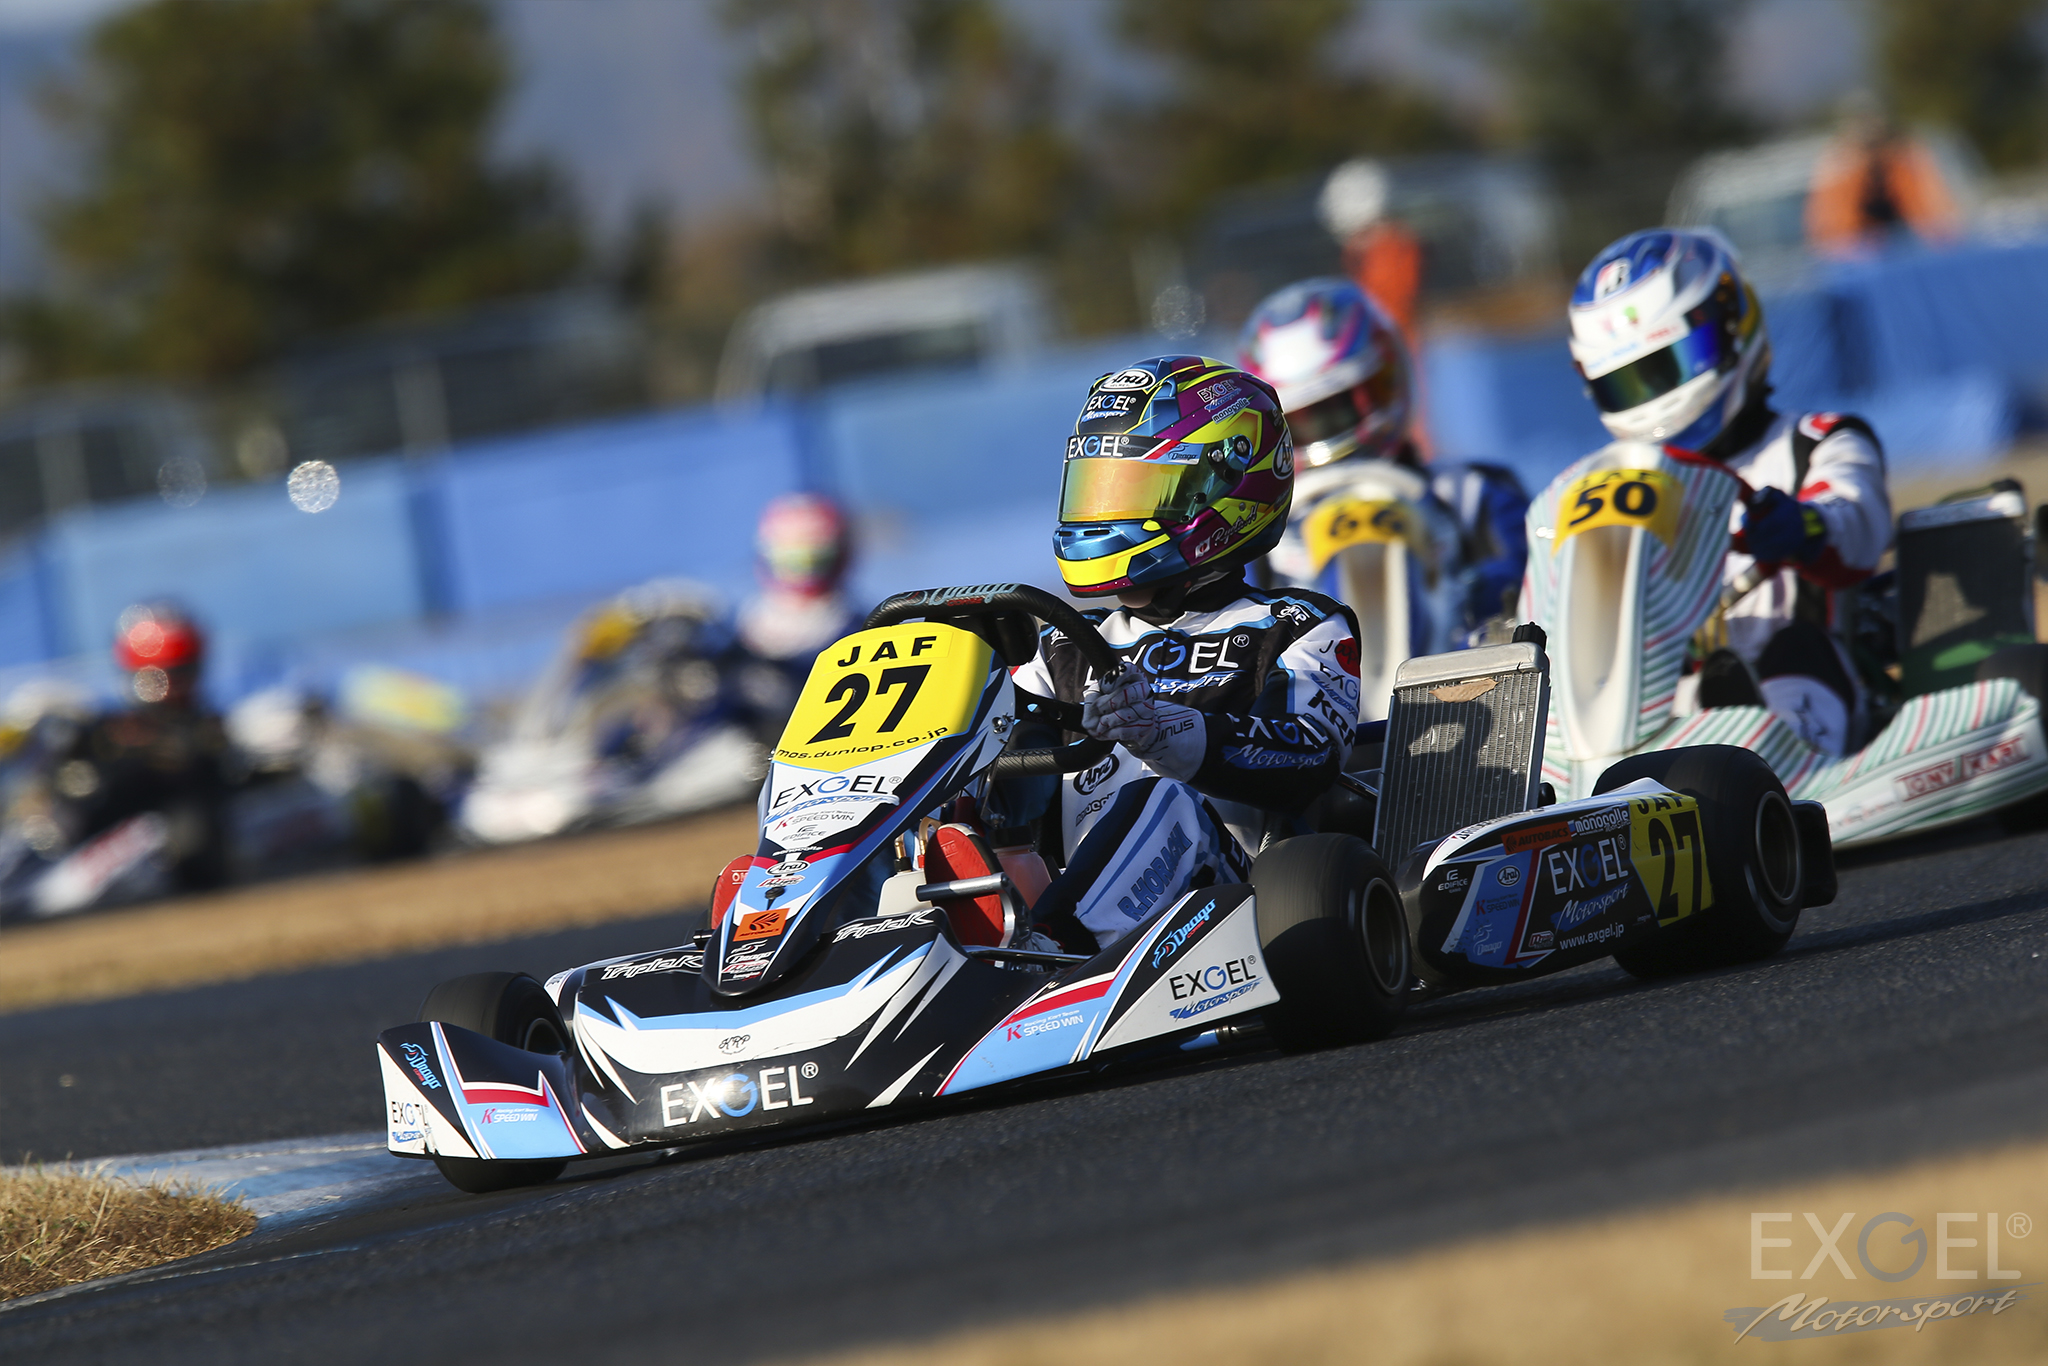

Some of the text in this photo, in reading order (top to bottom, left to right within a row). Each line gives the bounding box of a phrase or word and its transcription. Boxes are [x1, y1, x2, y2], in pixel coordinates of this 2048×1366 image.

[1569, 481, 1657, 527] 50
[837, 636, 937, 667] JAF
[1084, 636, 1239, 687] GEL
[1320, 661, 1358, 700] EXG
[805, 664, 932, 745] 27
[1308, 689, 1356, 746] KR
[1518, 826, 1570, 847] AUTOBACS
[1548, 836, 1629, 896] EXGEL
[1648, 810, 1703, 921] 27
[1559, 921, 1625, 950] www.exgel.jp
[1023, 1020, 1061, 1037] SPEED
[1060, 1014, 1084, 1027] WIN
[493, 1114, 520, 1123] SPEED
[519, 1113, 538, 1122] WIN
[660, 1064, 815, 1128] EXGEL
